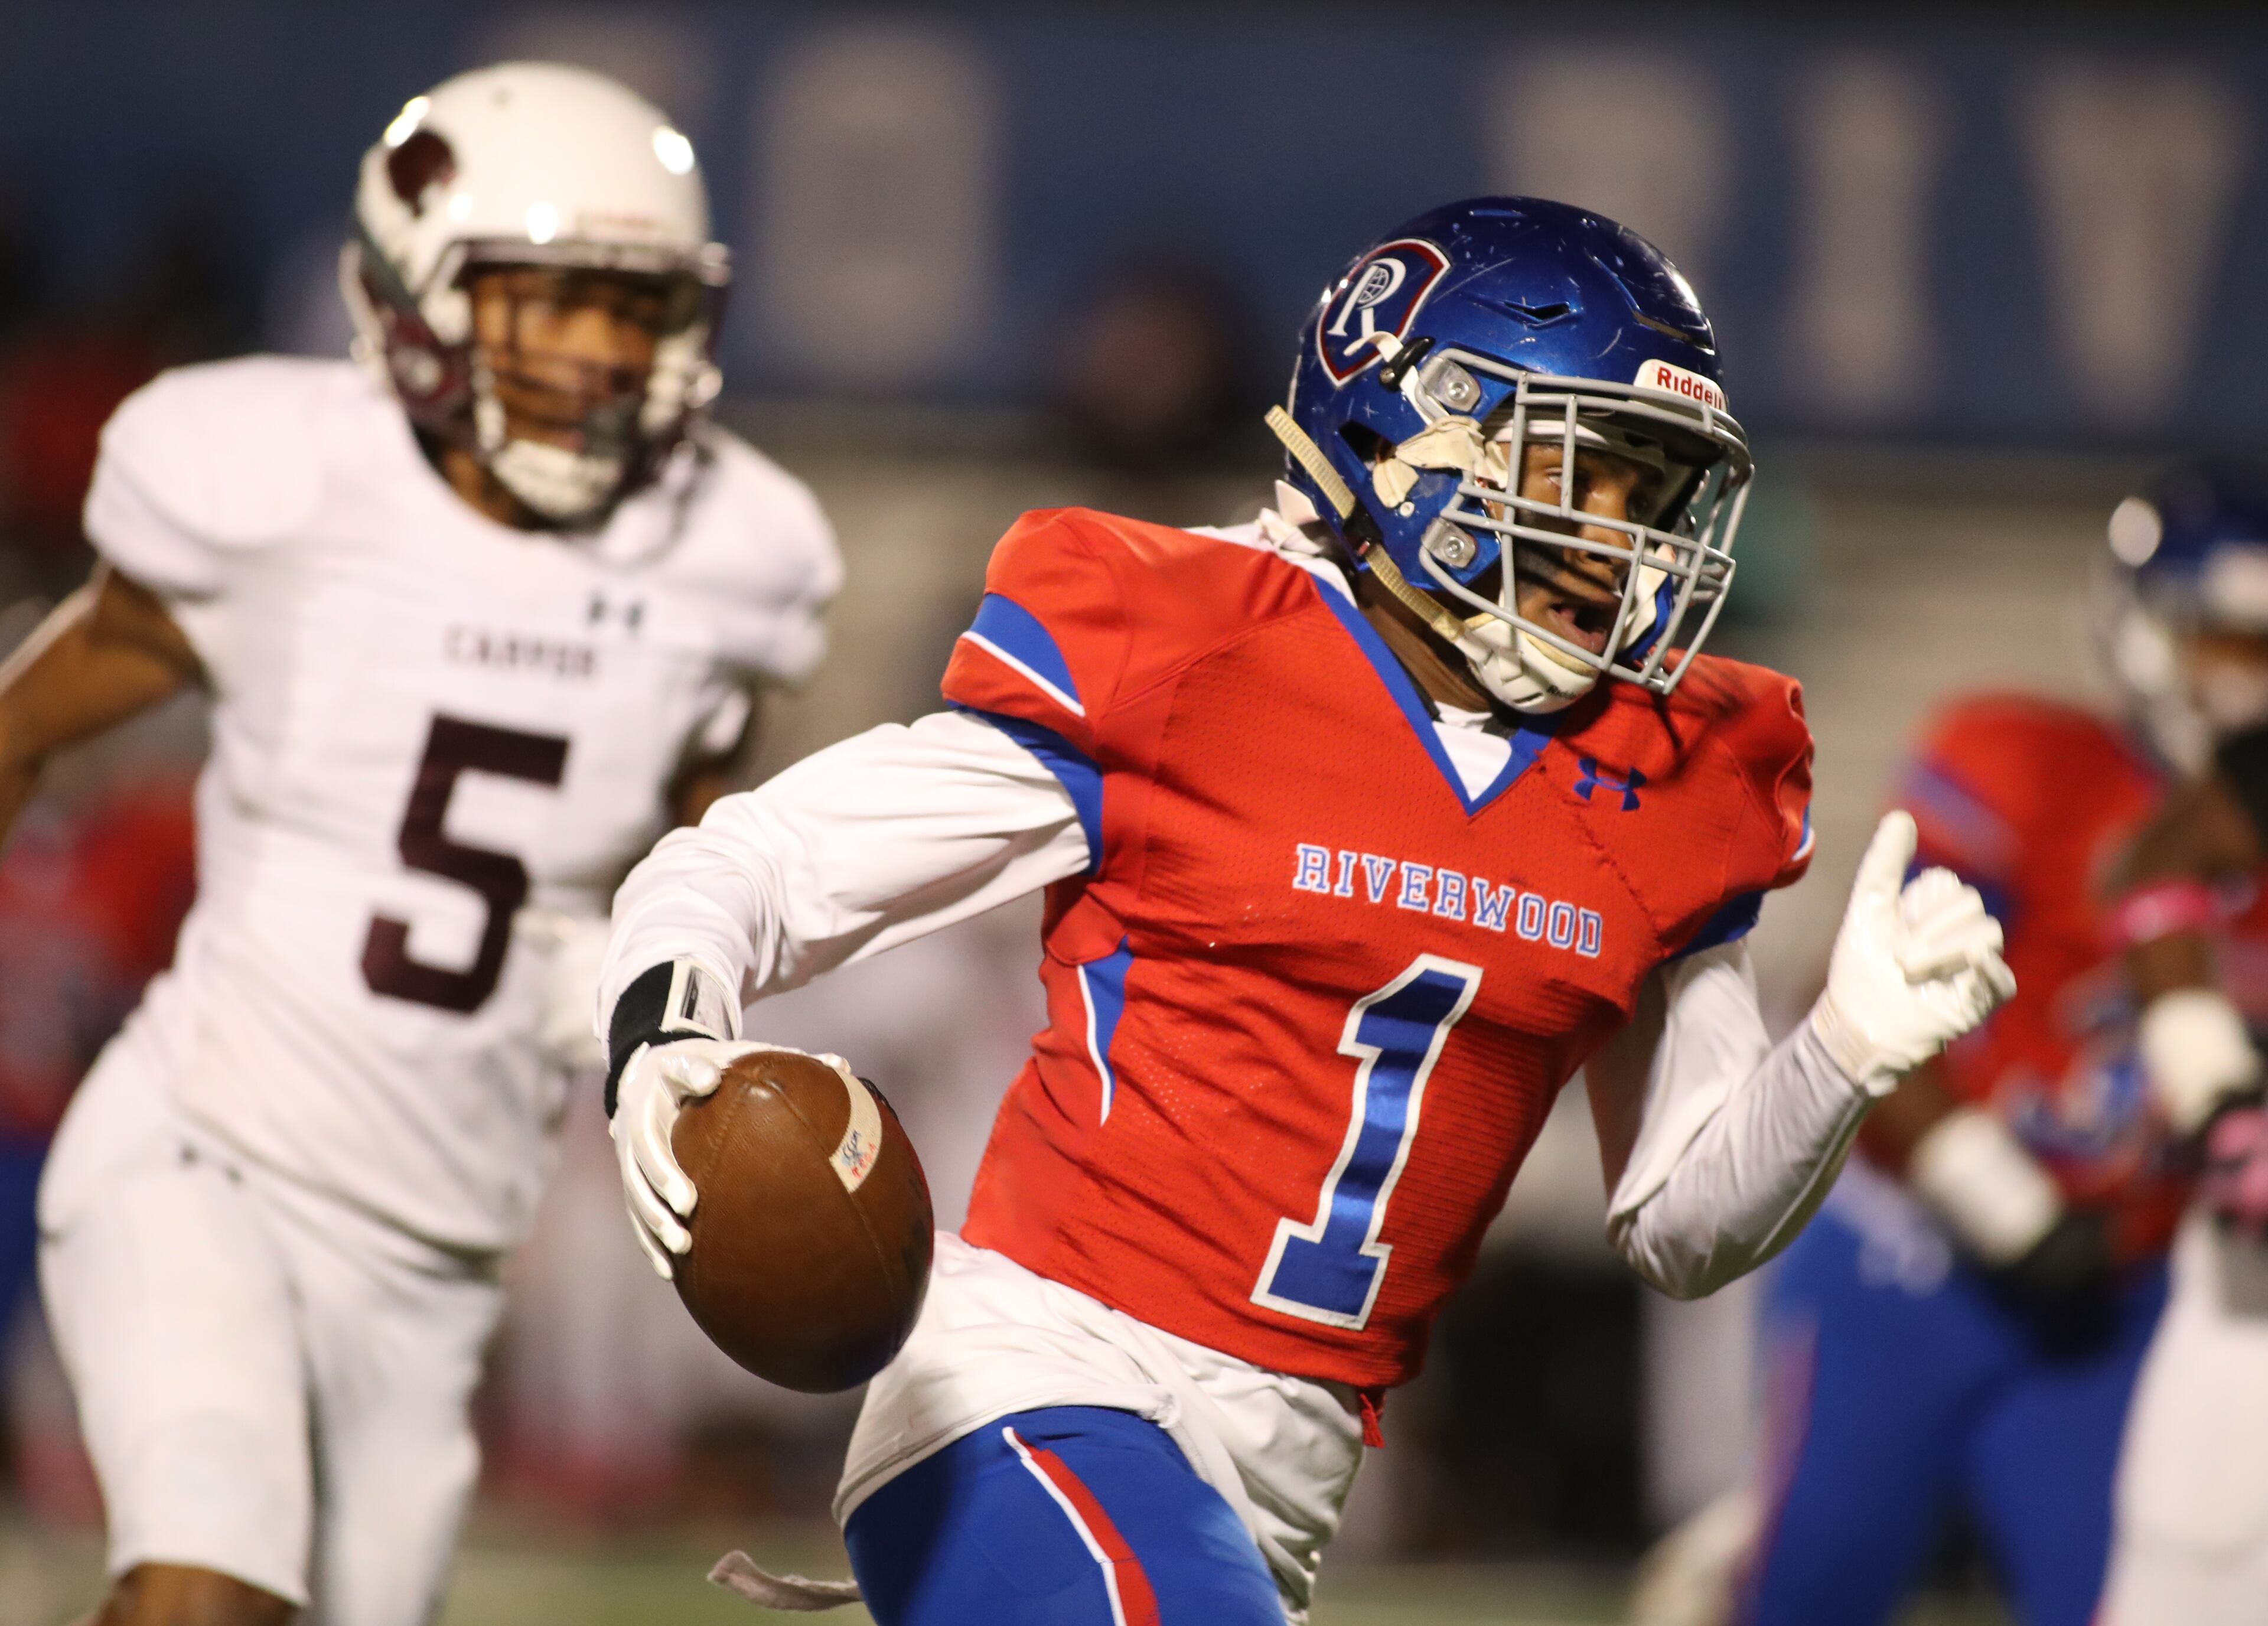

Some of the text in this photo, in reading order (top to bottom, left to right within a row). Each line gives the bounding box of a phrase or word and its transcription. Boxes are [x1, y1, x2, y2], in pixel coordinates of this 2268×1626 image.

[1657, 366, 1722, 410] Riddell
[361, 713, 571, 1014] 5
[1292, 843, 1602, 957] RIVERWOOD
[1250, 953, 1484, 1331] 1
